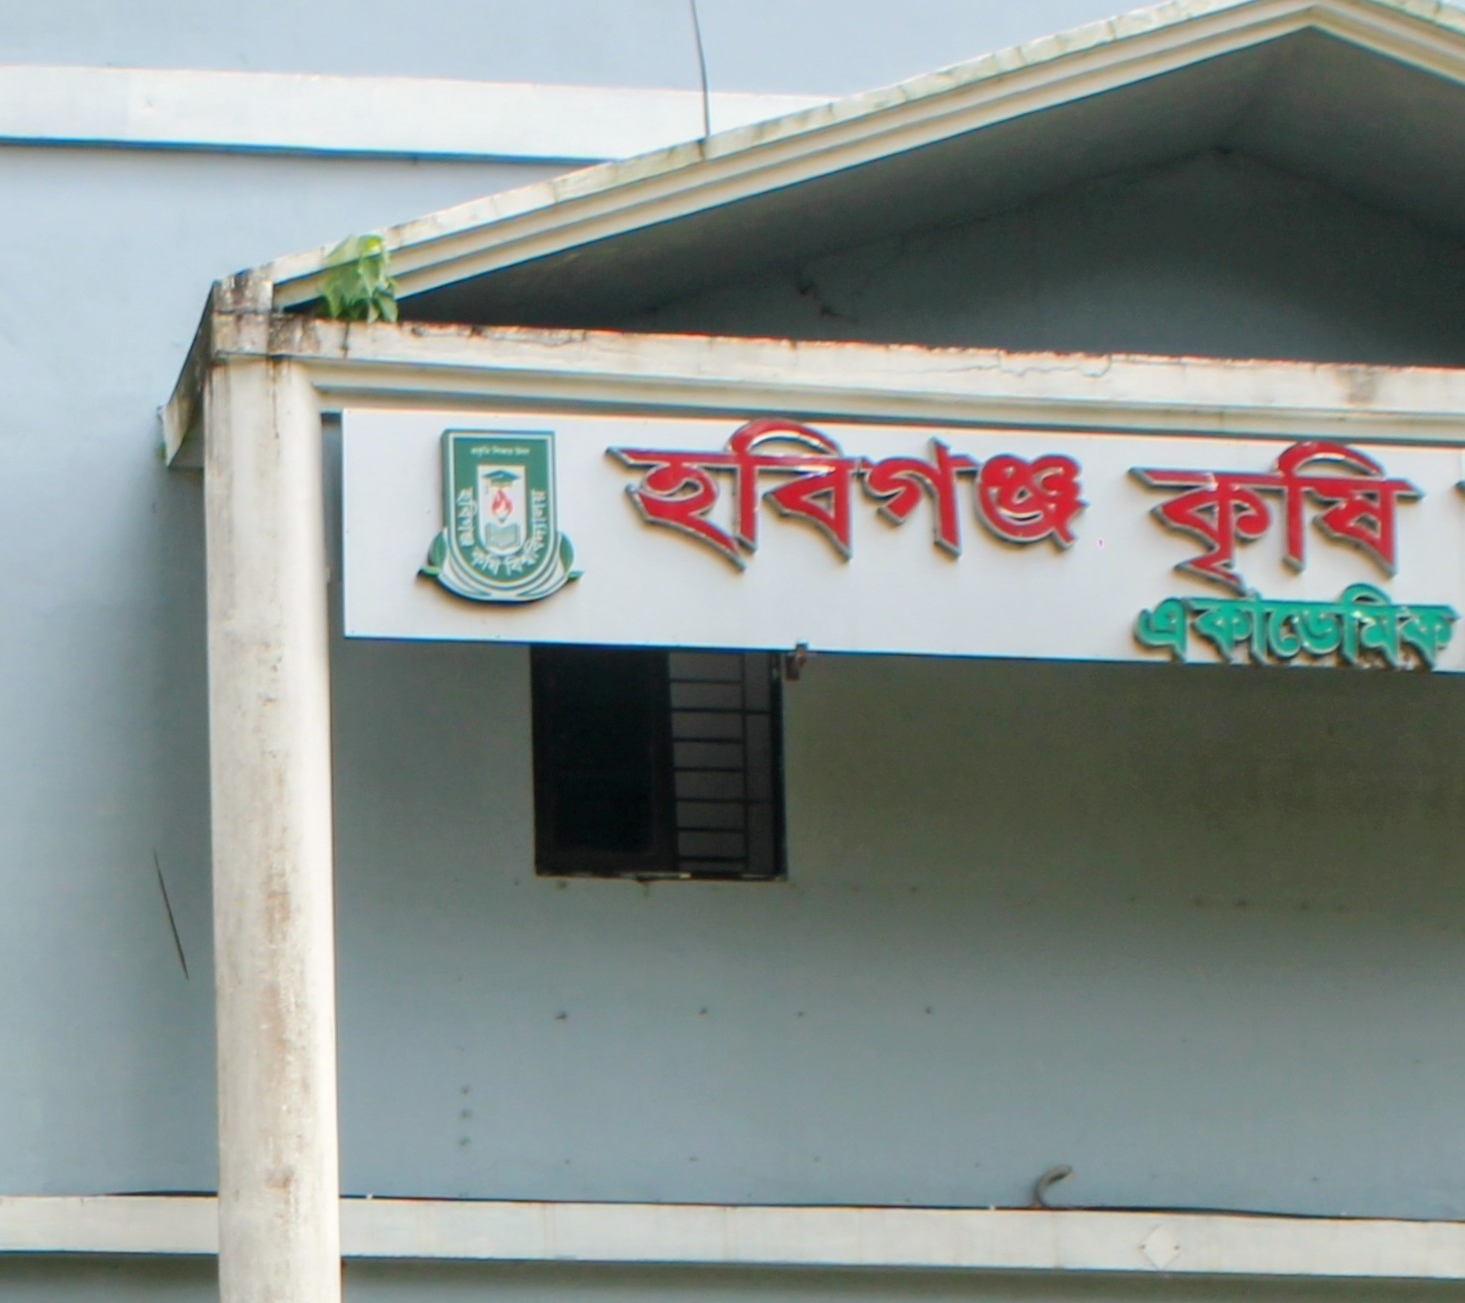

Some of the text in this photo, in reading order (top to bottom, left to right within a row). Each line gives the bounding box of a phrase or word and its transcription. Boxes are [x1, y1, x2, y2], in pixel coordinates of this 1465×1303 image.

[604, 417, 1089, 572] হবিগঞ্জ
[1129, 440, 1425, 594] কৃষি
[1132, 582, 1460, 671] একাডেমিক
